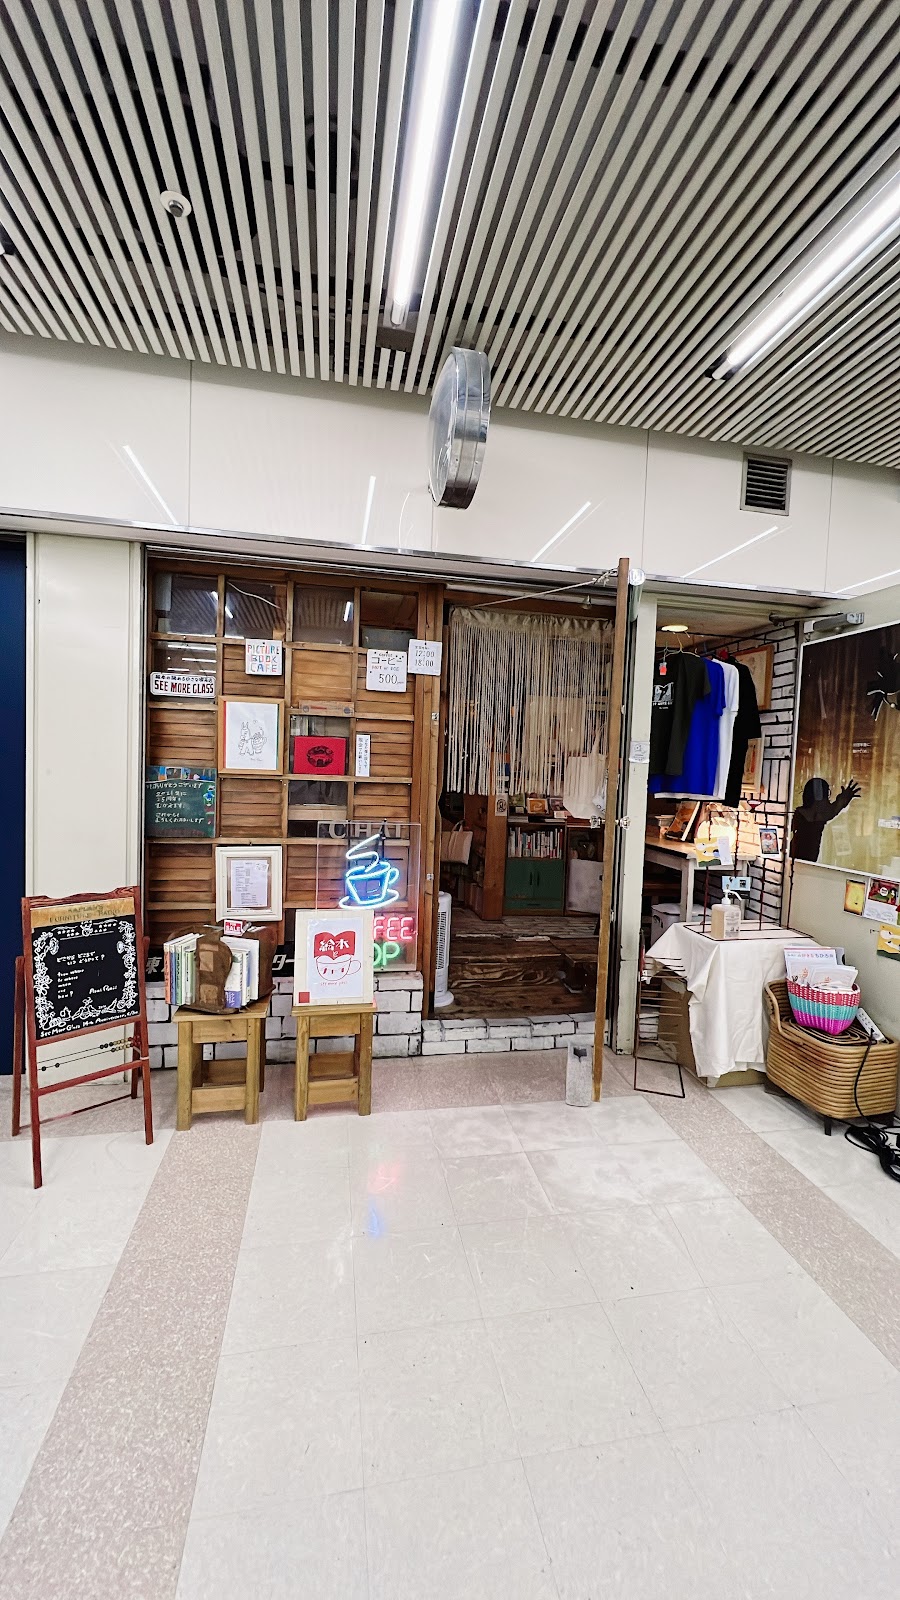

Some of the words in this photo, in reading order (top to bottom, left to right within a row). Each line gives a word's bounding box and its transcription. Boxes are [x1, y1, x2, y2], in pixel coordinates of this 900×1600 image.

[247, 645, 279, 654] PICTURE
[415, 650, 435, 658] 12:00
[251, 655, 277, 663] BOOK
[371, 656, 402, 666] コーヒー
[250, 663, 277, 672] CAFE
[379, 673, 398, 684] 500
[154, 680, 168, 691] SEE
[171, 682, 191, 693] MORE
[193, 683, 214, 694] GLASS
[319, 938, 350, 952] 絵本
[146, 956, 162, 975] 東
